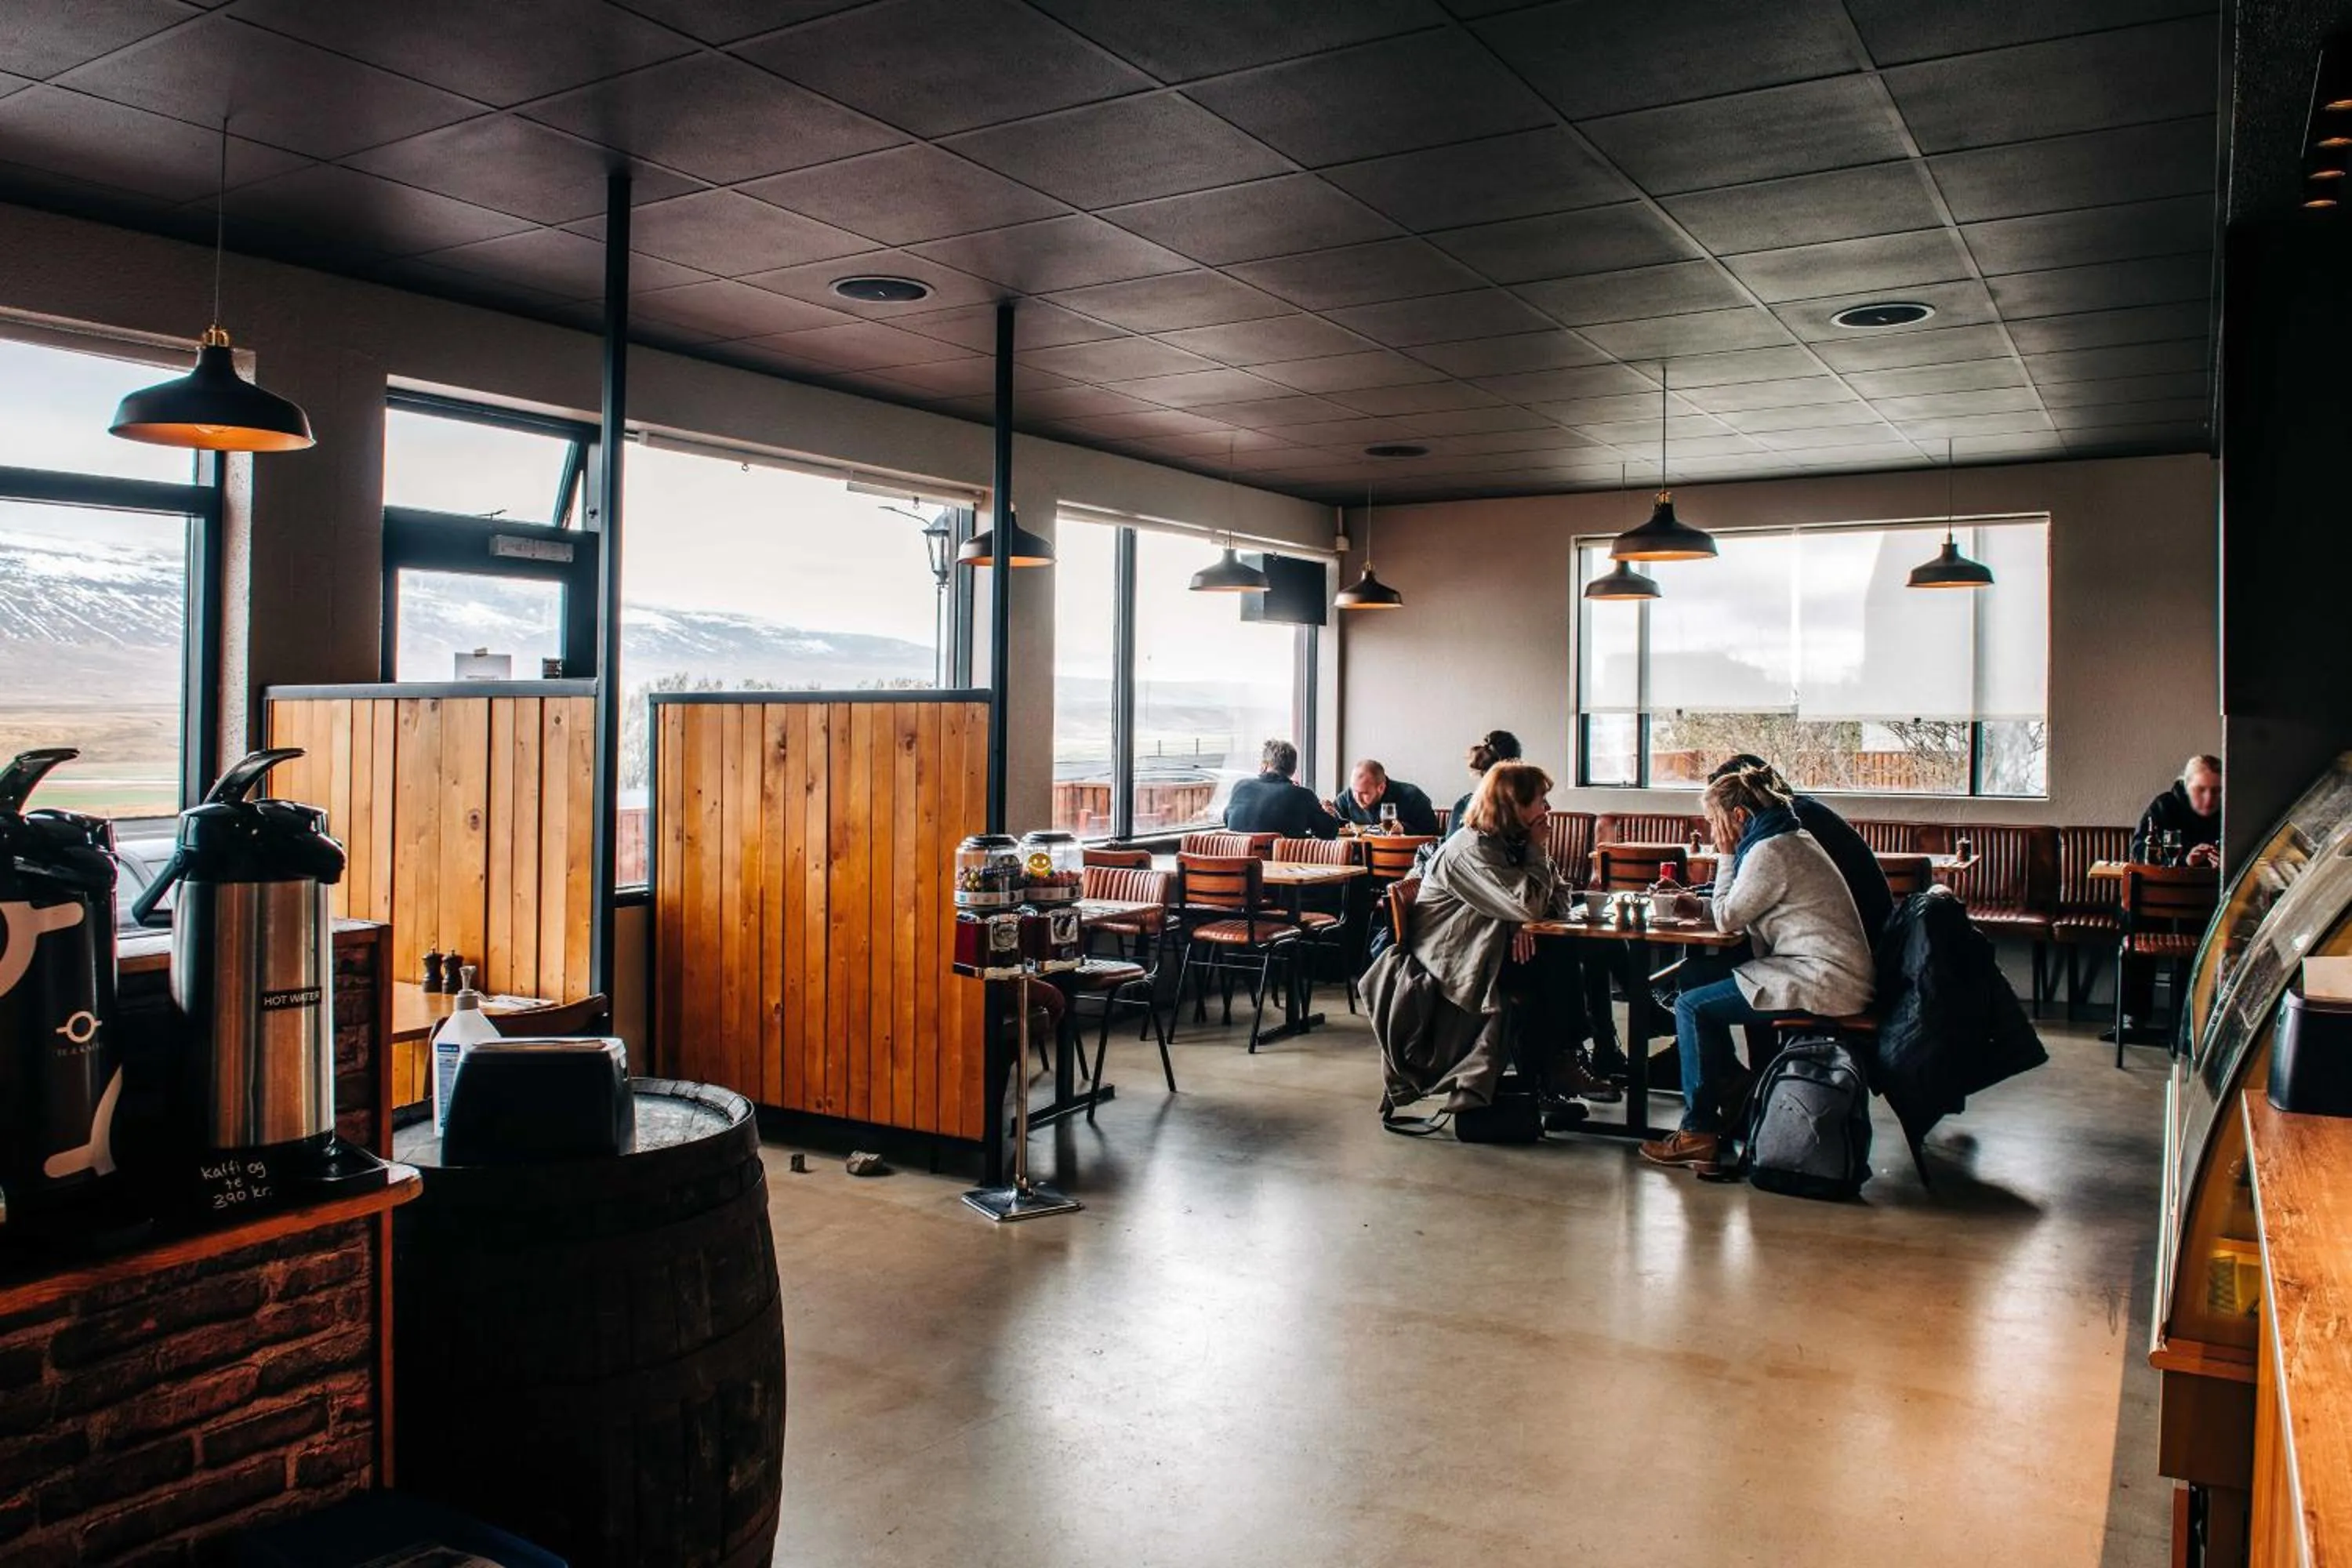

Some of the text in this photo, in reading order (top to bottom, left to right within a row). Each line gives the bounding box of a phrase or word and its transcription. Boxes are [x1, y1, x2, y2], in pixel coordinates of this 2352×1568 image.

[263, 990, 321, 1006] HOT WATER
[246, 1160, 267, 1179] og
[212, 1191, 247, 1209] 390
